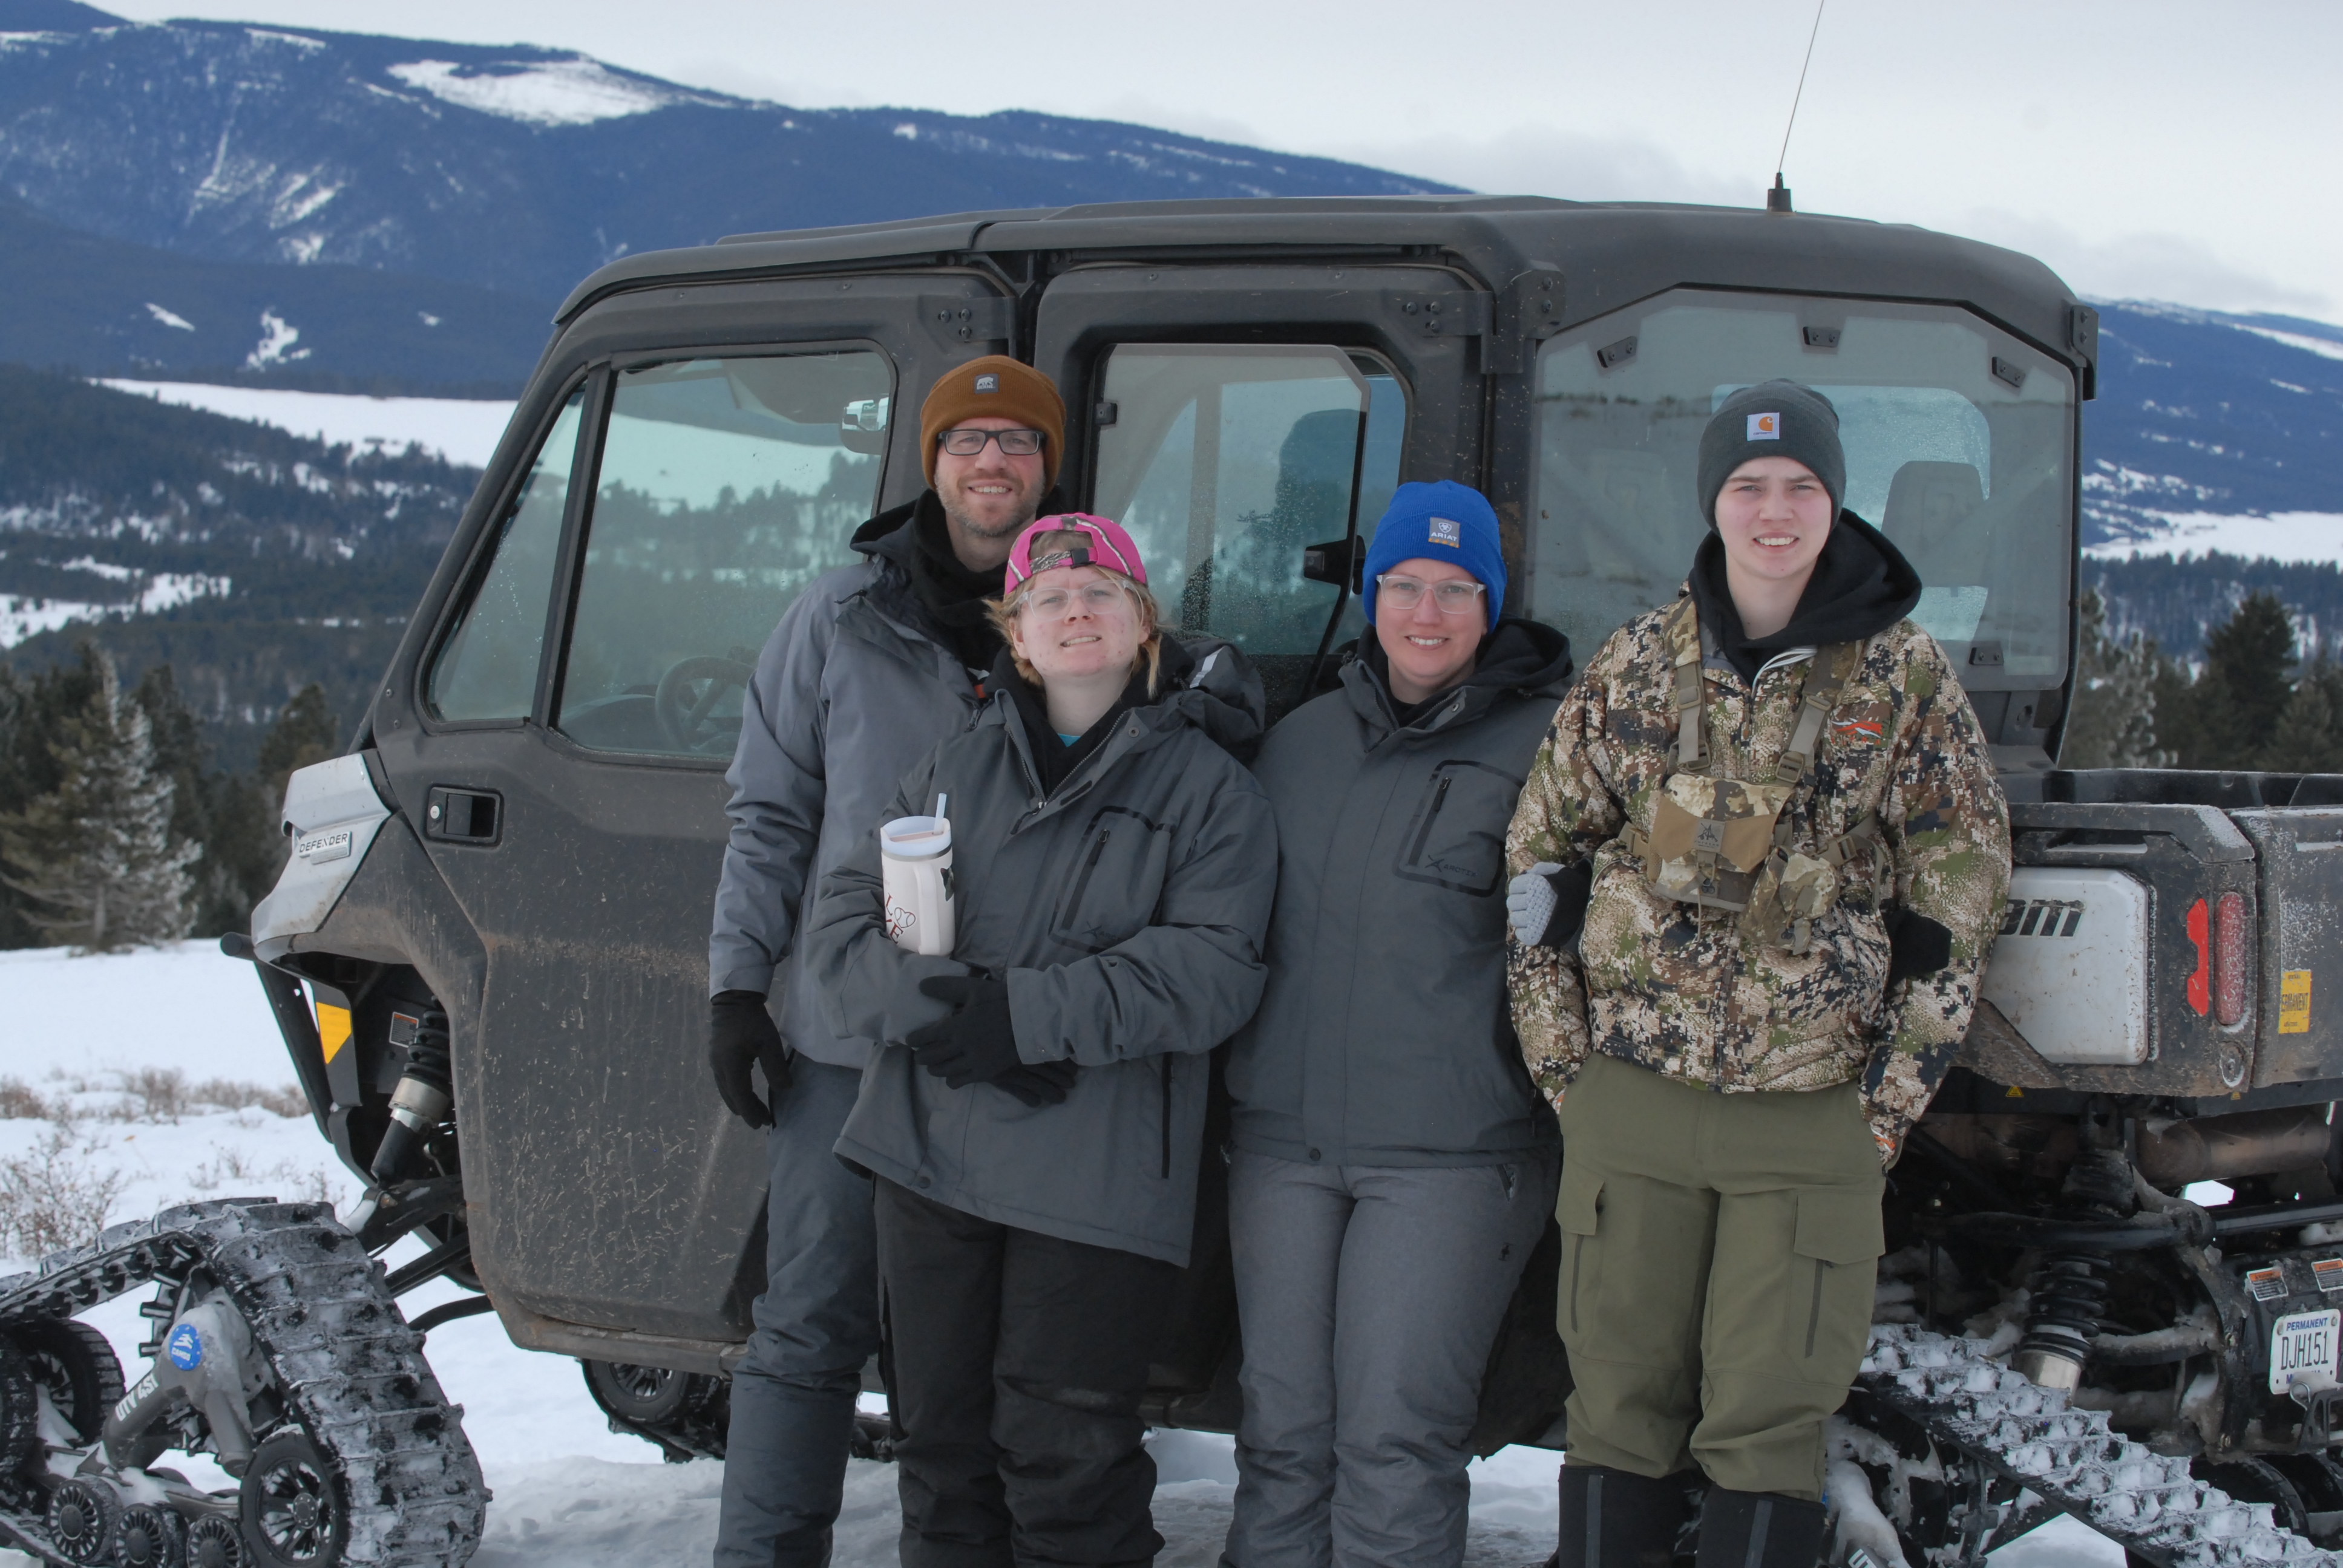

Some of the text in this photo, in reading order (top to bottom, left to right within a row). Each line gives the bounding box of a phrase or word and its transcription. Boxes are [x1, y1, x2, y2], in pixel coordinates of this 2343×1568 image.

[1430, 532, 1458, 541] ARIAT
[299, 833, 348, 853] DEFENDER
[2286, 1318, 2328, 1331] PERMANENT
[2281, 1331, 2328, 1370] DJH151
[115, 1390, 138, 1422] UTV
